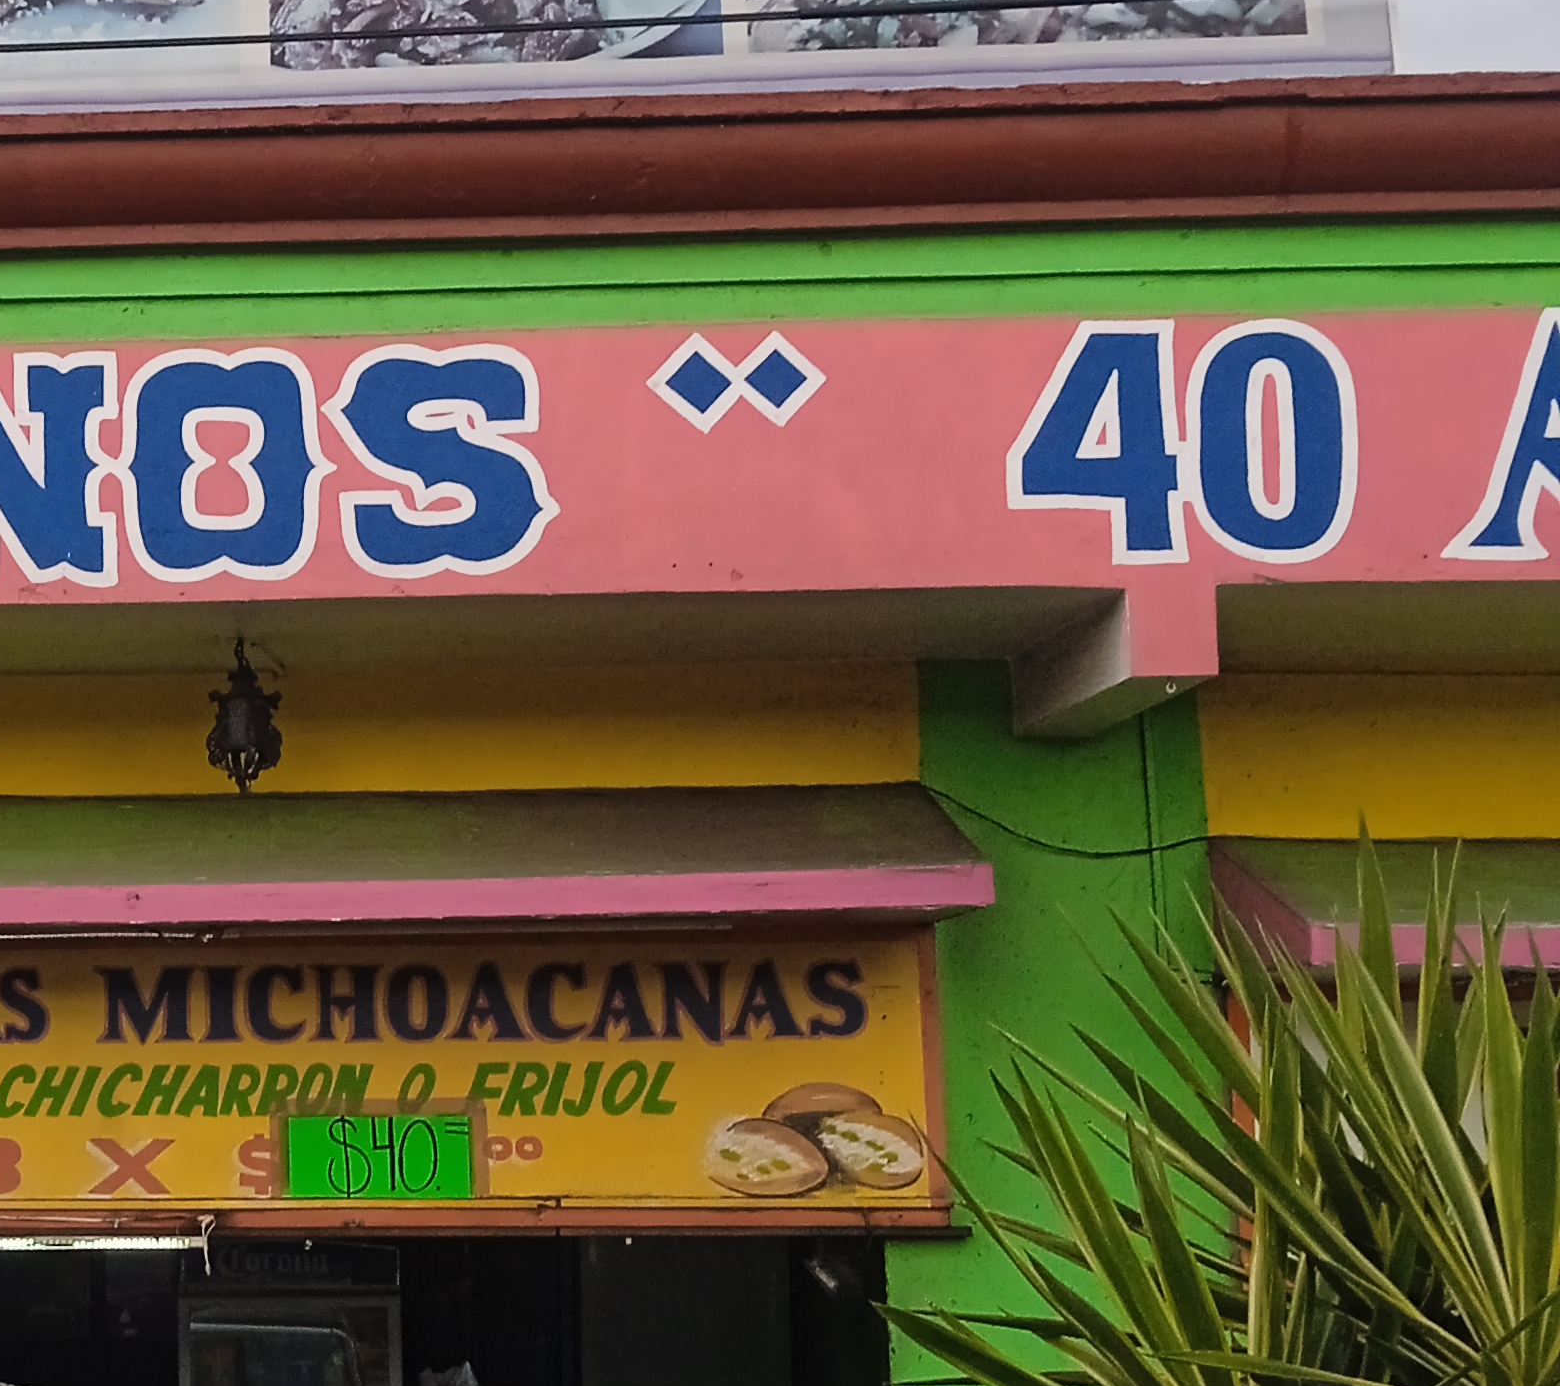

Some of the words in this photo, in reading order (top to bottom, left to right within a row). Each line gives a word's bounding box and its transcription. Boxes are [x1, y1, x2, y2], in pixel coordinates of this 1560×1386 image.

[1006, 318, 1359, 565] 40
[94, 957, 869, 1046] MICHOACANAS
[396, 1062, 437, 1115] O
[467, 1060, 677, 1118] FRIJOL
